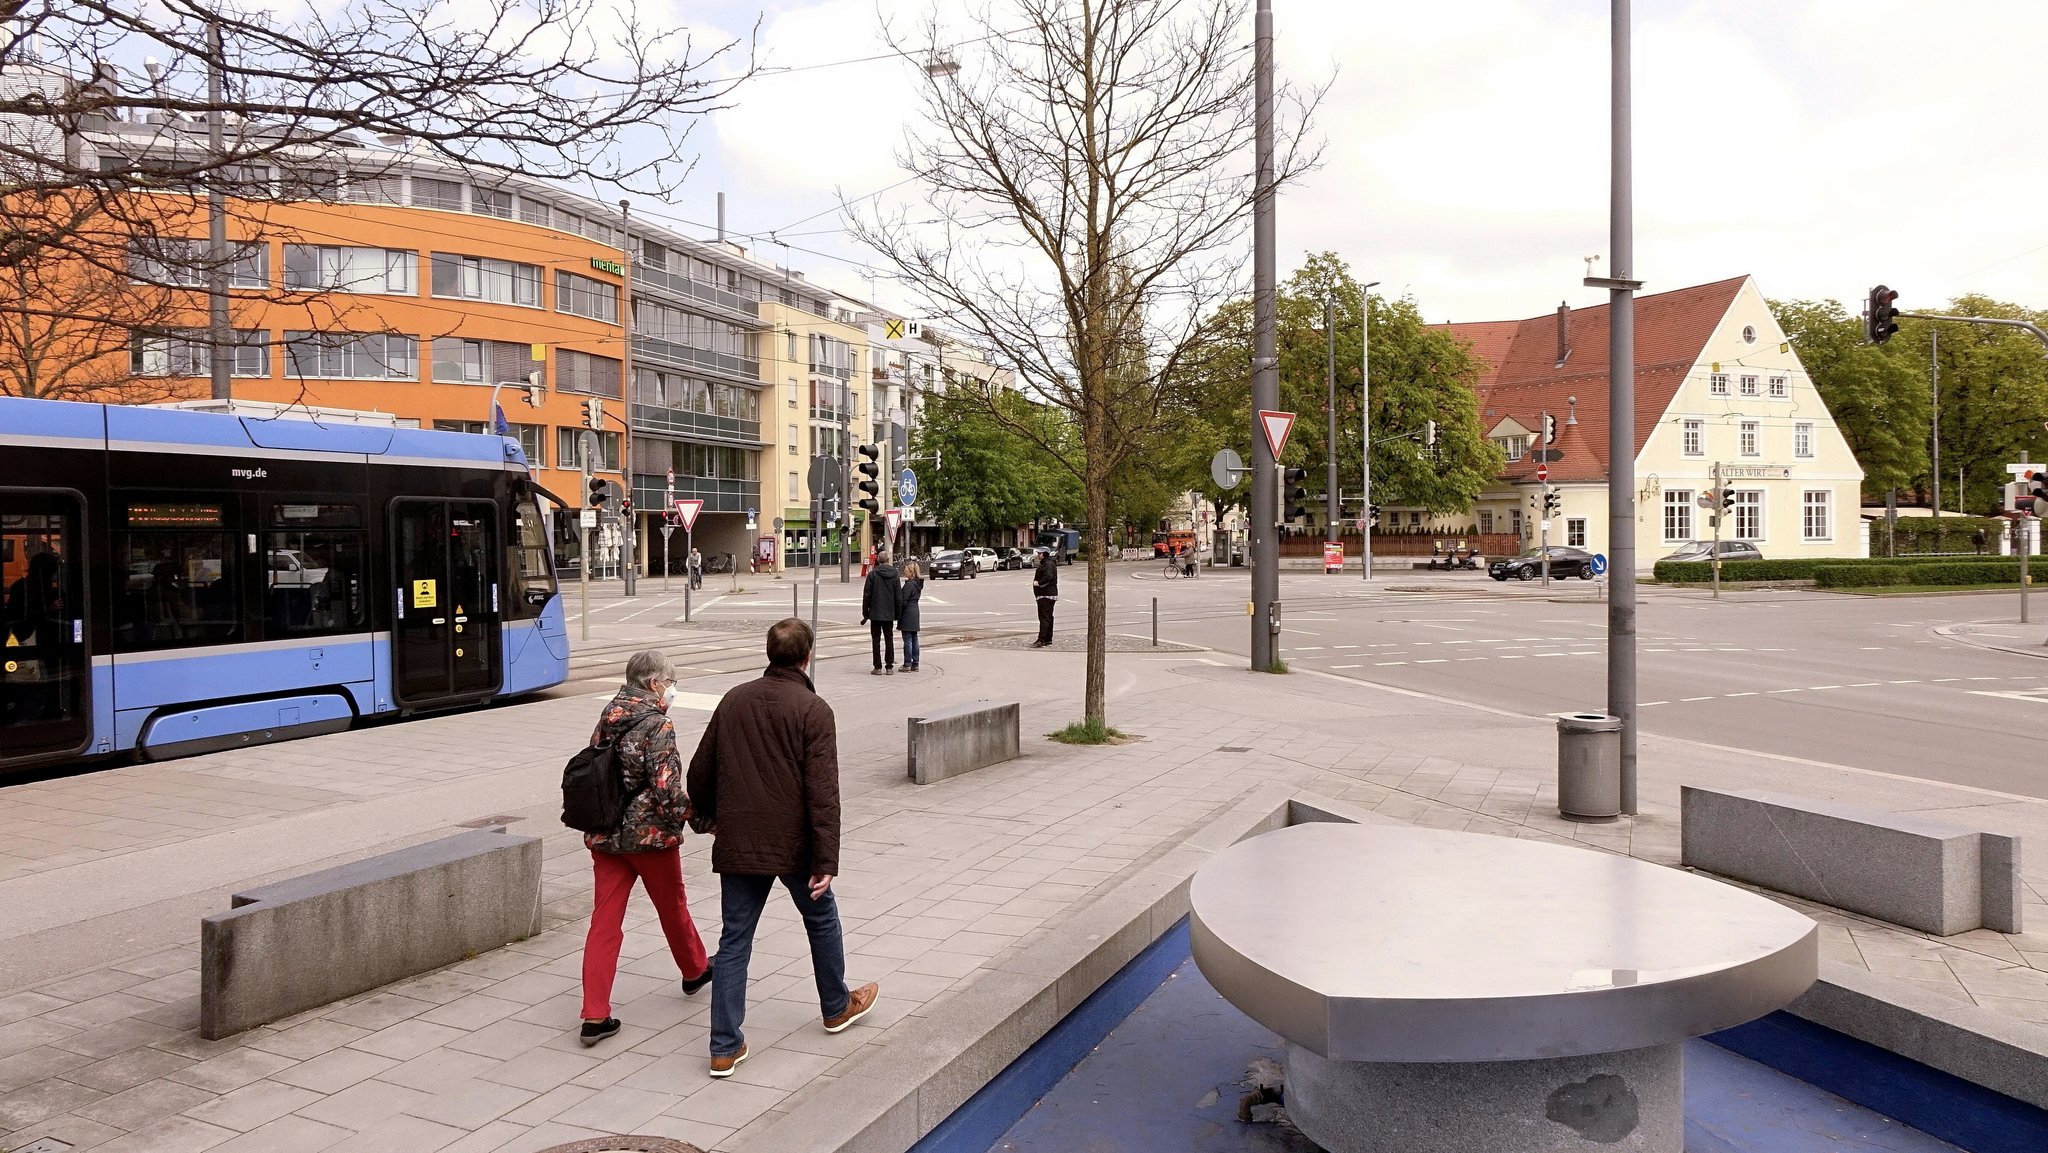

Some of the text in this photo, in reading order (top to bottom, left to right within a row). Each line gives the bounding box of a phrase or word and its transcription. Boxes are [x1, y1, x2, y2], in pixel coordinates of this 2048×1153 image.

[909, 322, 917, 334] H
[231, 467, 267, 480] mvg.de
[1720, 468, 1745, 477] ALTER
[1745, 468, 1767, 478] WIRT
